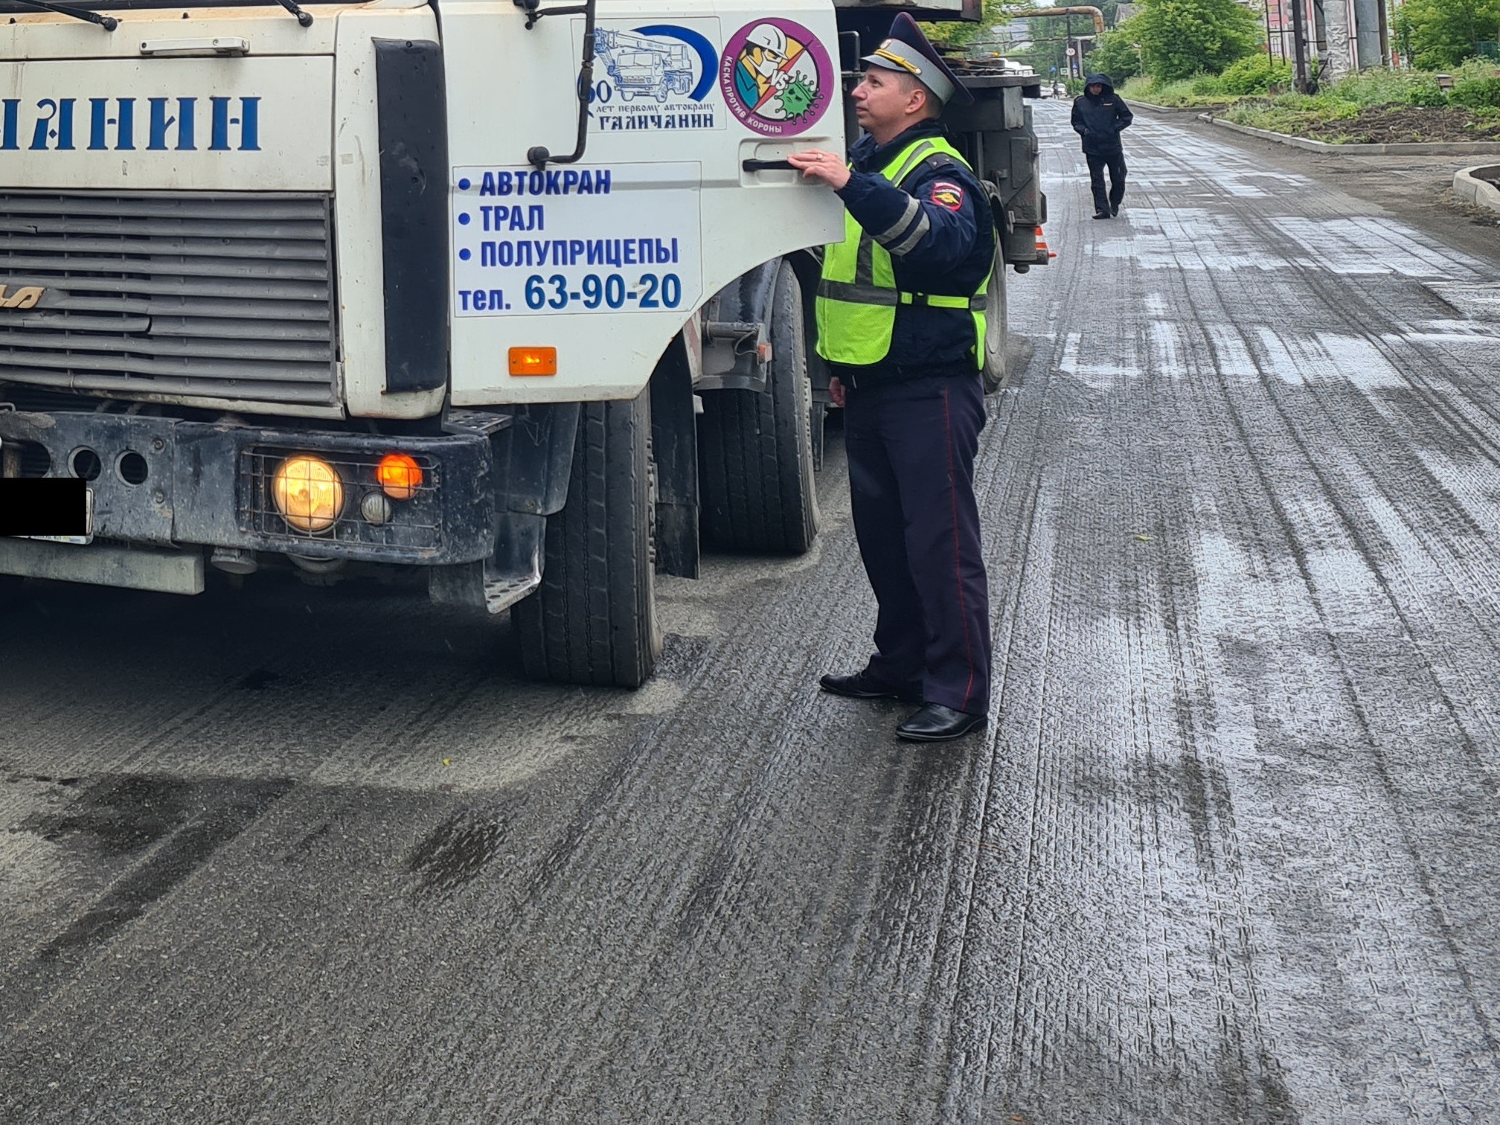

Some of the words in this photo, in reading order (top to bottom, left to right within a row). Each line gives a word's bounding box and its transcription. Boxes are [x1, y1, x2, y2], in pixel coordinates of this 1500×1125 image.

[723, 55, 734, 85] КАСКА
[771, 69, 789, 90] VS
[724, 86, 747, 119] ПРОТИВ
[599, 114, 714, 130] ГАЛИЧАНИН
[747, 117, 782, 133] КОРОНЫ
[479, 170, 612, 196] АВТОКРАН
[479, 205, 545, 232] ТРАЛ
[481, 237, 679, 268] ПОЛУПРИЦЕПЫ
[458, 289, 512, 311] тел.
[524, 273, 682, 310] 63-90-20
